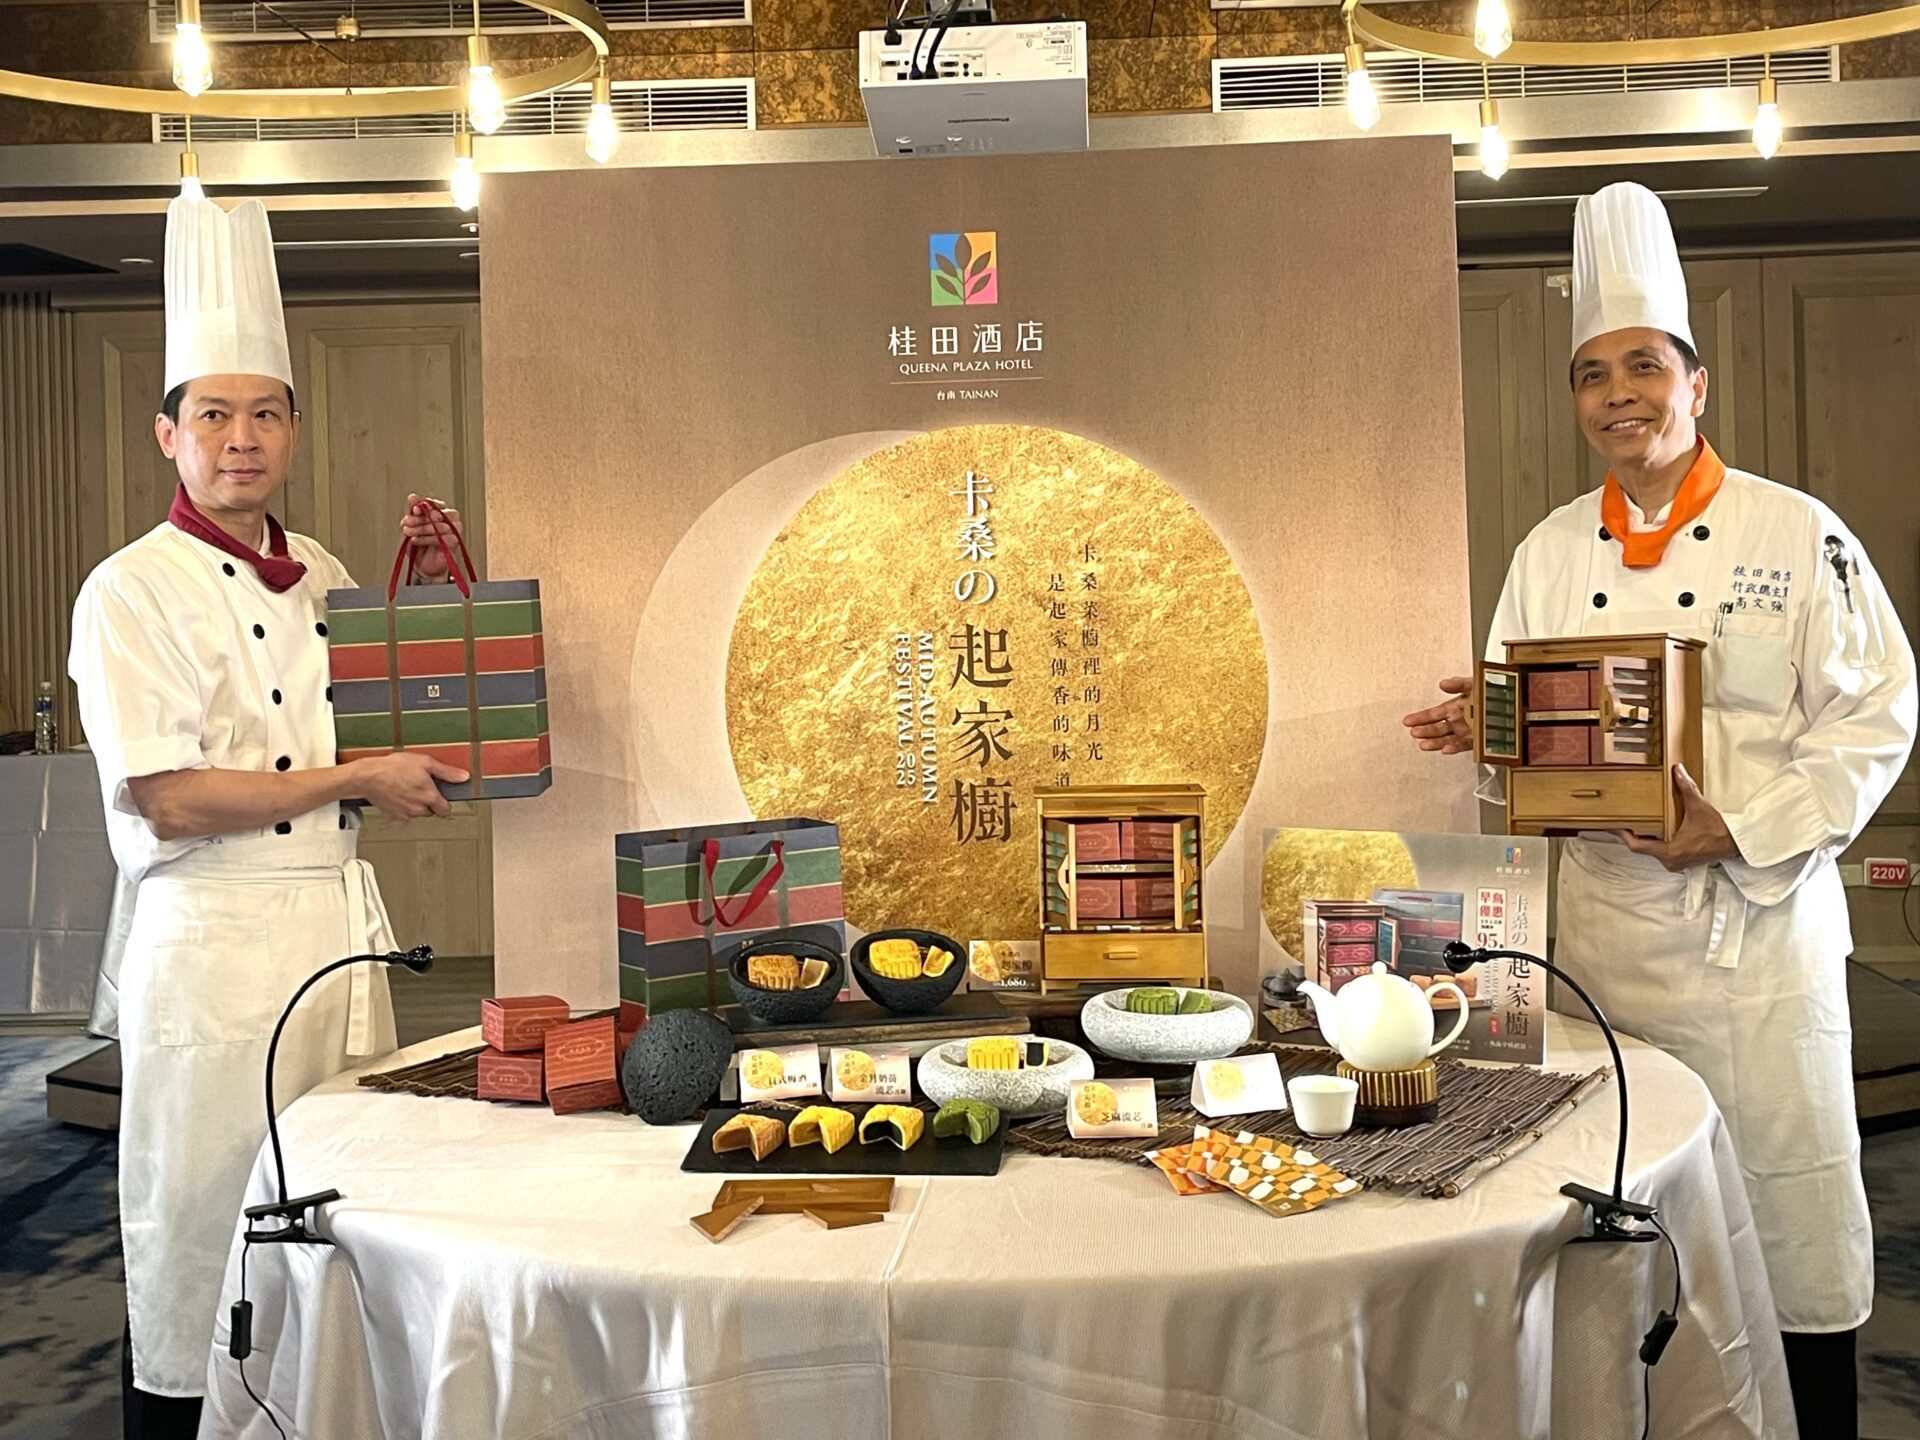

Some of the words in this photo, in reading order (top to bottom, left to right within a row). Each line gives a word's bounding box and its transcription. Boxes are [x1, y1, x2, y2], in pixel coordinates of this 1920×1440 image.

[888, 321, 1043, 356] 桂田酒店
[899, 363, 948, 375] QUEENA
[953, 361, 991, 372] PLAZA
[996, 359, 1034, 370] HOTEL
[960, 389, 999, 399] TAINAN
[895, 633, 914, 749] FESTIVAL
[918, 632, 939, 803] MID-AUTUMN
[1872, 867, 1906, 880] 220V
[1000, 978, 1027, 988] 1,680
